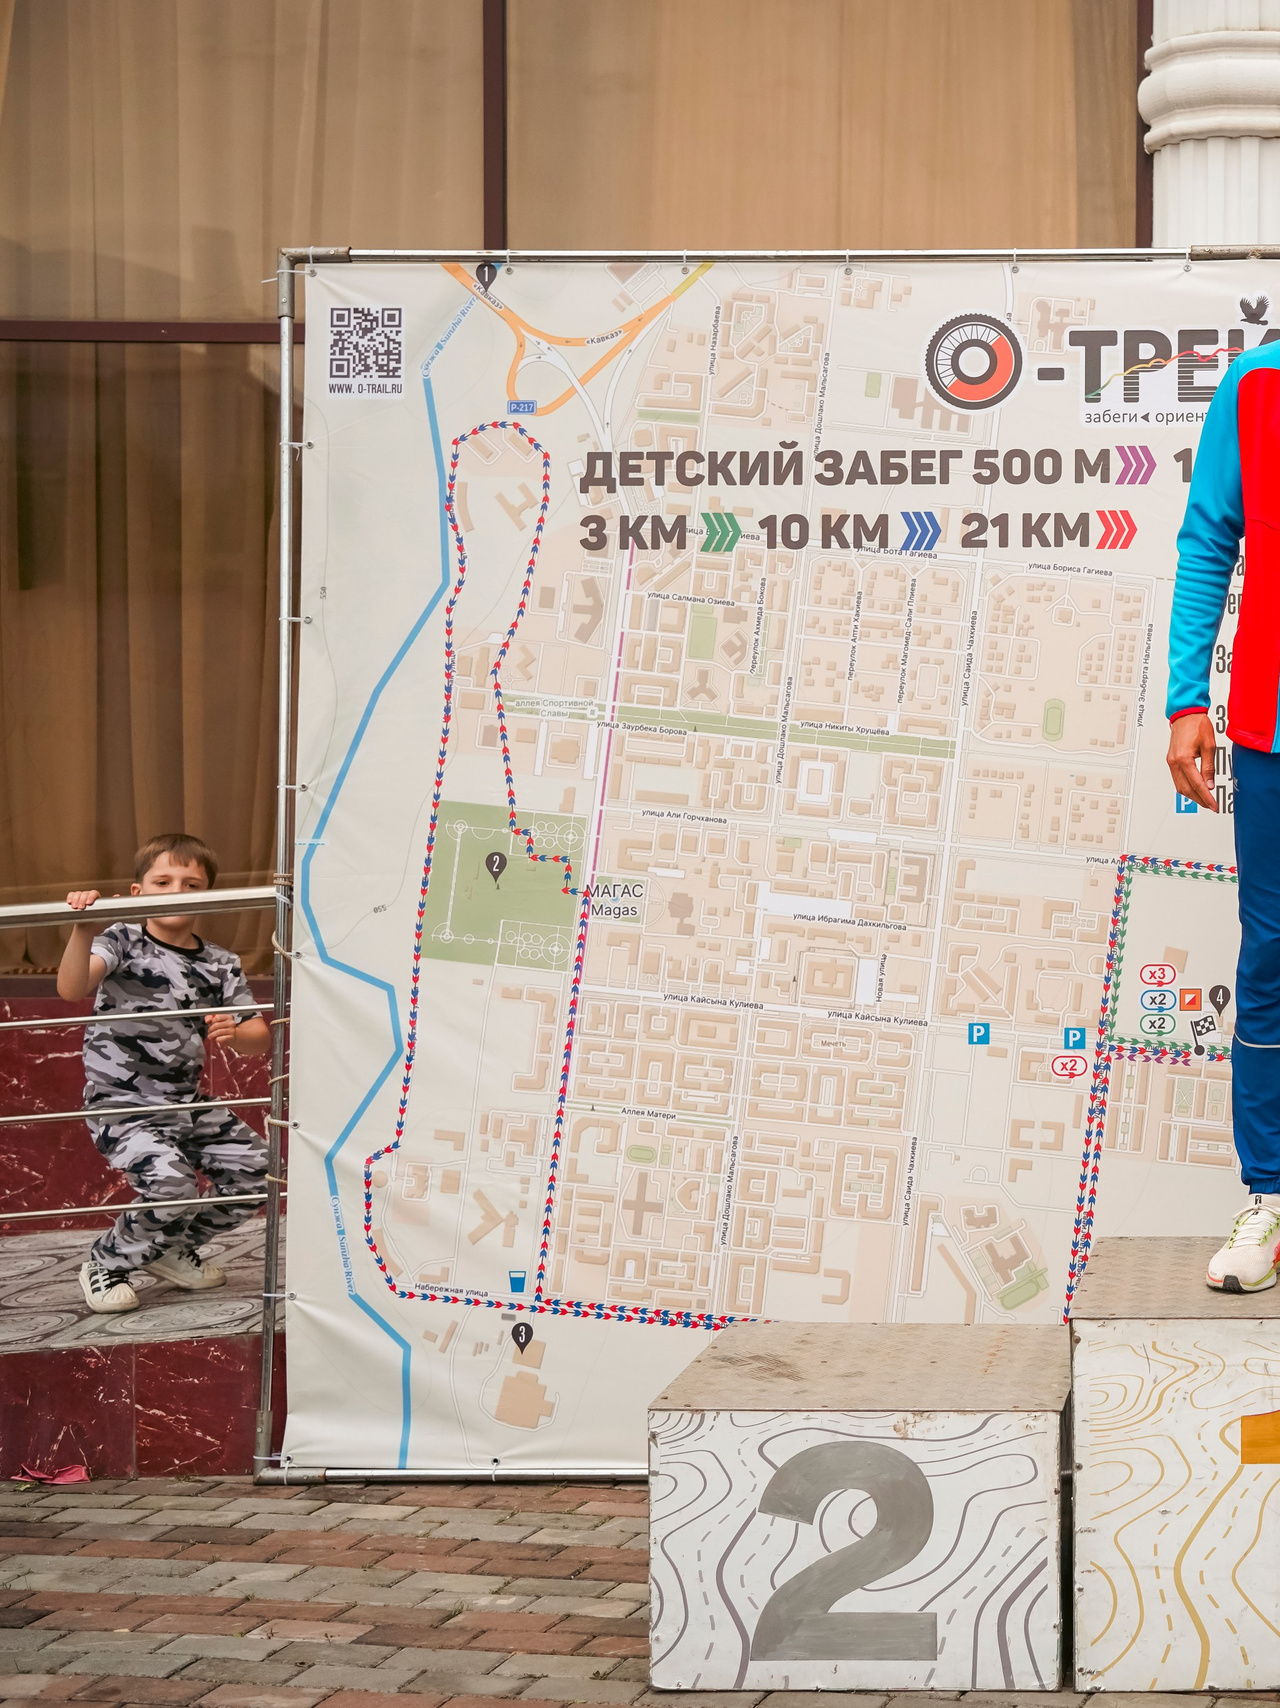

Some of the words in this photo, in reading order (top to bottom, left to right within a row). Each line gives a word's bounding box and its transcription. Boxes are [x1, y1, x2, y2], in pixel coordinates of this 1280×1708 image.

[586, 328, 623, 345] «Кавказ»
[710, 305, 721, 348] Назарбаева
[708, 350, 717, 375] улица
[819, 352, 830, 398] Мальсагова
[328, 384, 354, 395] WWW.
[815, 400, 825, 434] Дошлако
[1085, 410, 1138, 424] забеги
[580, 441, 803, 493] ДЕТСКИЙ
[814, 449, 963, 486] ЗАБЕГ
[972, 449, 1062, 485] 500
[1074, 448, 1111, 484] М
[579, 515, 607, 550] 3
[619, 514, 687, 550] КМ
[758, 513, 809, 550] 10
[821, 513, 889, 549] КМ
[961, 512, 1008, 549] 21
[1022, 512, 1090, 548] КМ
[1028, 561, 1051, 572] улица
[1053, 563, 1080, 574] Бориса
[1082, 566, 1113, 577] Гагиева
[647, 591, 671, 602] улица
[672, 593, 706, 604] Салмана
[707, 596, 735, 607] Озиева
[758, 577, 767, 606] Бокова
[908, 578, 917, 606] Плиева
[754, 608, 763, 636] Ахмеда
[968, 610, 978, 651] Чахкиева
[848, 641, 857, 681] переулок
[854, 590, 863, 623] Хакиева
[901, 608, 914, 665] Магомед-Сали
[1143, 623, 1154, 663] Нальгиева
[749, 637, 760, 675] переулок
[964, 653, 973, 681] Саида
[897, 667, 907, 704] переулок
[961, 683, 969, 707] улица
[1139, 664, 1150, 702] Эльберта
[782, 676, 793, 724] Мальсагова
[597, 720, 620, 731] улица
[621, 722, 658, 734] Заурбека
[659, 726, 688, 736] Борова
[800, 720, 823, 731] улица
[824, 722, 854, 733] Никиты
[855, 725, 890, 736] Хрущёва
[1137, 703, 1145, 728] улица
[777, 729, 786, 761] Дошлако
[775, 763, 783, 784] улица
[642, 808, 665, 819] улица
[667, 811, 680, 821] Али
[682, 812, 728, 824] Горчханова
[591, 904, 637, 918] Magas
[793, 913, 818, 924] улица
[820, 915, 856, 927] Ибрагима
[857, 919, 907, 931] Дахкильгова
[879, 953, 888, 978] улица
[663, 992, 689, 1002] улица
[690, 994, 728, 1006] Кайсына
[729, 998, 764, 1010] Кулиева
[875, 978, 884, 1002] Новая
[828, 1010, 852, 1020] улица
[854, 1012, 892, 1024] Кайсына
[893, 1016, 929, 1027] Кулиева
[821, 1039, 847, 1048] Мечеть
[621, 1107, 646, 1117] Аллея
[647, 1109, 677, 1121] Матери
[727, 1134, 740, 1187] Мальсагова
[907, 1136, 918, 1174] Чахкиева
[904, 1176, 914, 1202] Саида
[722, 1188, 733, 1220] Дошлако
[902, 1204, 910, 1226] улица
[720, 1222, 728, 1246] улица
[414, 1282, 463, 1295] Набережная
[464, 1286, 489, 1298] улица
[750, 1440, 937, 1661] 2
